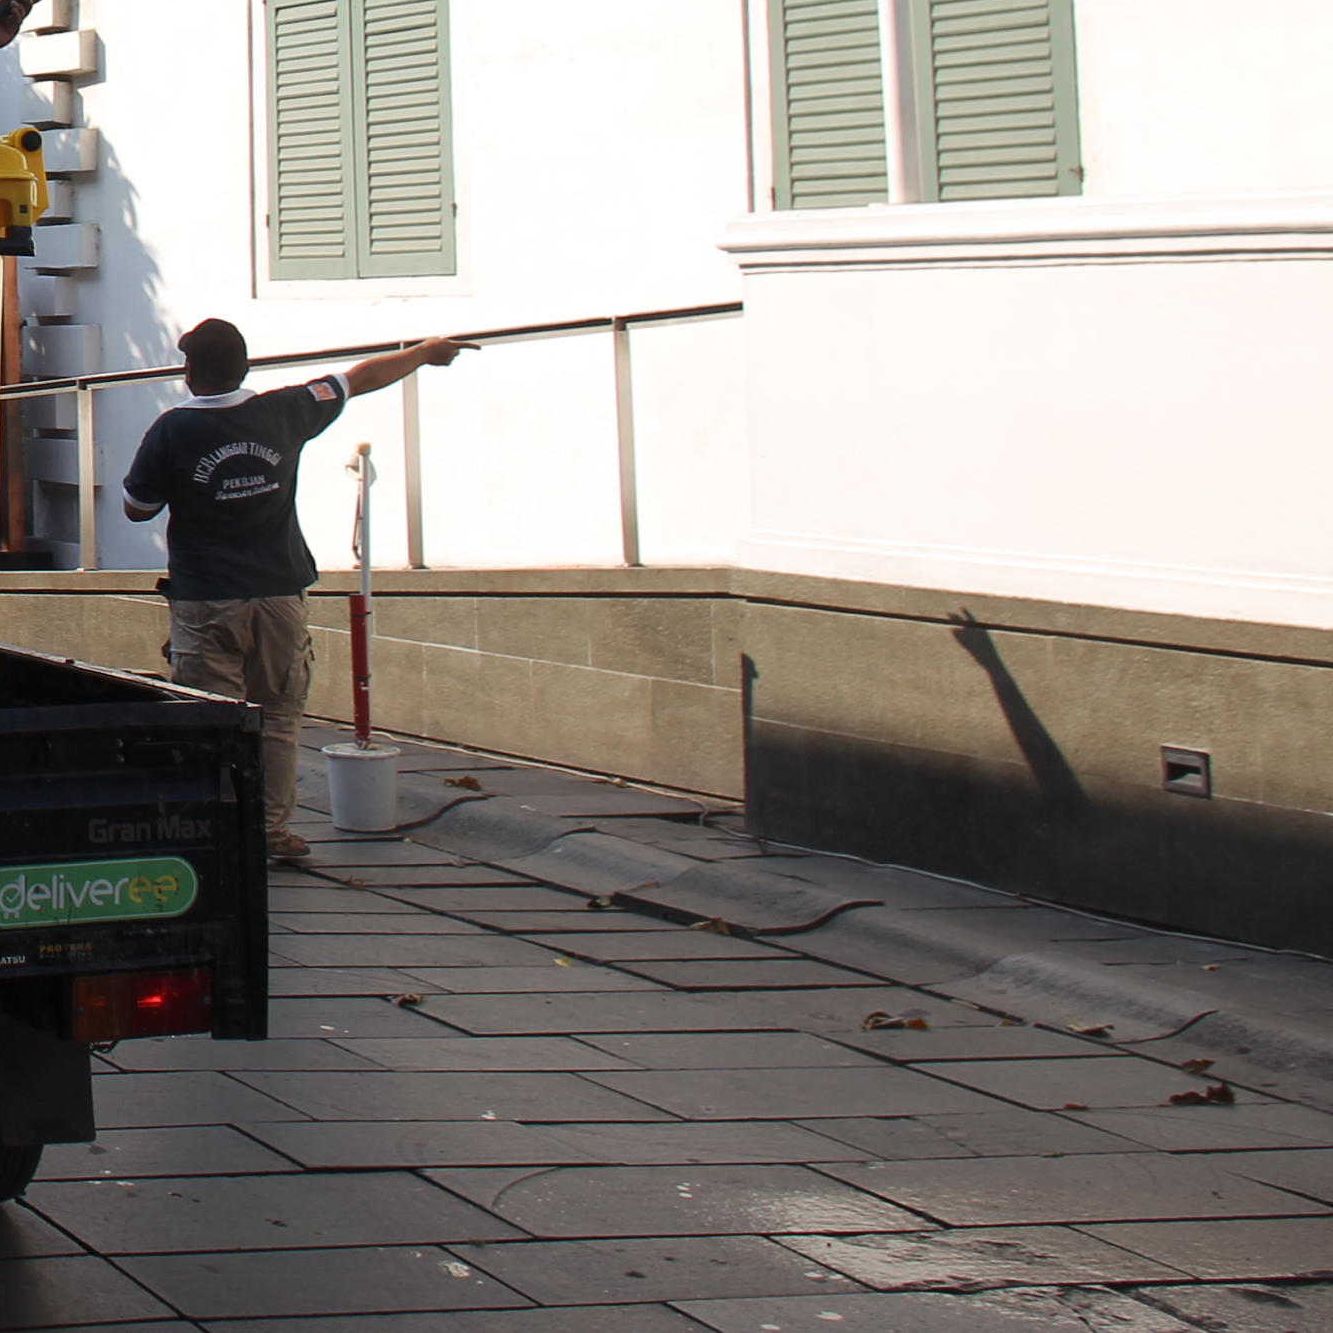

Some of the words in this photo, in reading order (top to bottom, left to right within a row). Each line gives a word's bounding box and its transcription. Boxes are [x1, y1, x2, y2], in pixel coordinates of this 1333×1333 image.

[249, 442, 283, 467] TINGGI
[88, 817, 152, 844] Gran
[156, 815, 213, 841] Max
